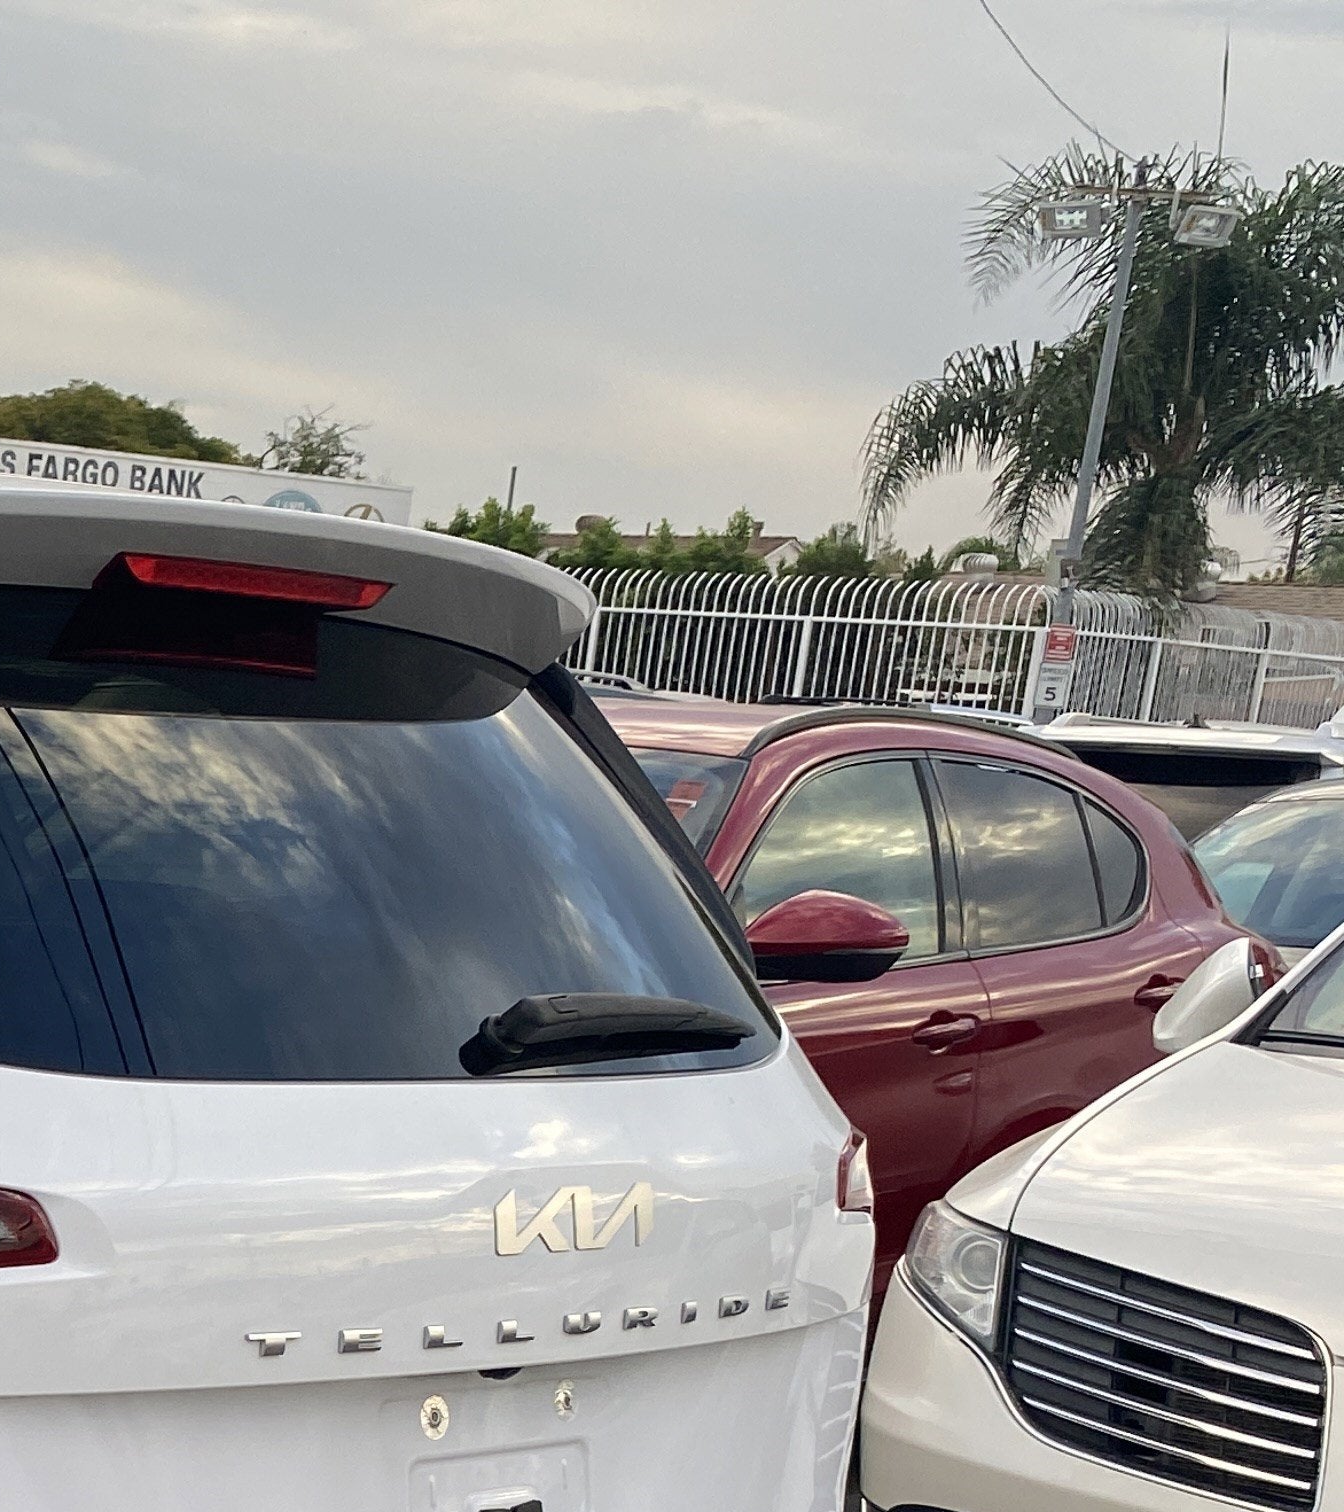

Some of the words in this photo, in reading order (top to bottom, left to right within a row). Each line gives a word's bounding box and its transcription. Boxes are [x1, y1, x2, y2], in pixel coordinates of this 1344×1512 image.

[27, 452, 119, 487] FARGO
[130, 464, 205, 500] BANK
[1044, 687, 1056, 701] 5
[494, 1181, 654, 1256] KIA
[245, 1287, 791, 1357] TELLURIDE
